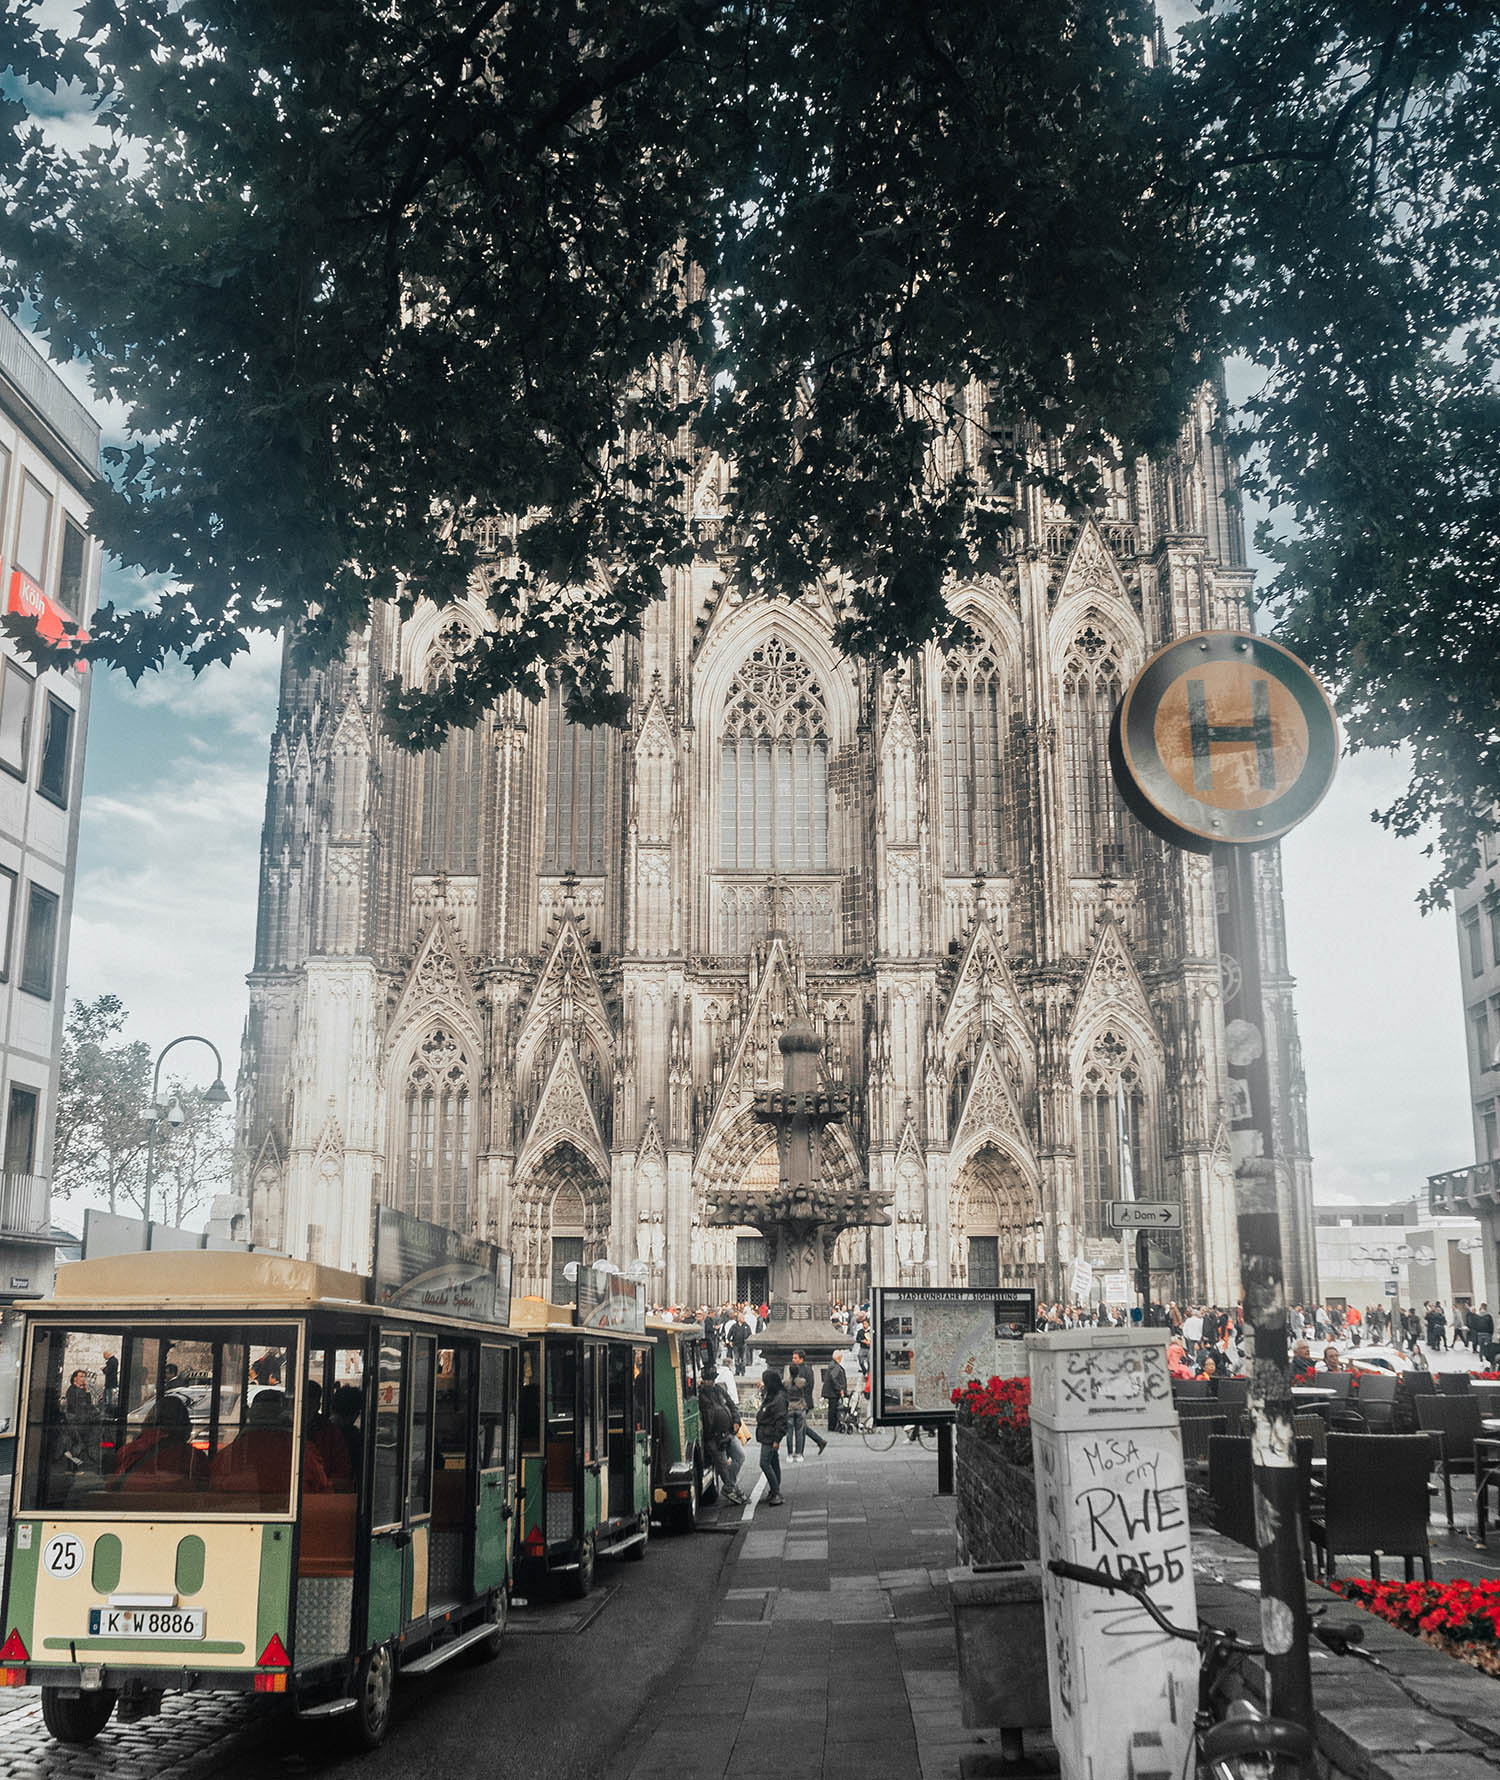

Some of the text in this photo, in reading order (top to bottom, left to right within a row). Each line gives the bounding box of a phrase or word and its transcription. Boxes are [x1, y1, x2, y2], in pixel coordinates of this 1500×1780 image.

[22, 580, 45, 616] Köln
[1186, 679, 1276, 792] H
[1134, 1210, 1156, 1220] Dom
[899, 1292, 964, 1301] STADTRUNDFAHRT
[973, 1292, 1018, 1301] SIGHTSEEING
[1075, 1485, 1185, 1552] RWE
[51, 1542, 77, 1570] 25
[107, 1613, 120, 1632] K
[133, 1614, 145, 1632] W
[149, 1613, 195, 1633] 8886
